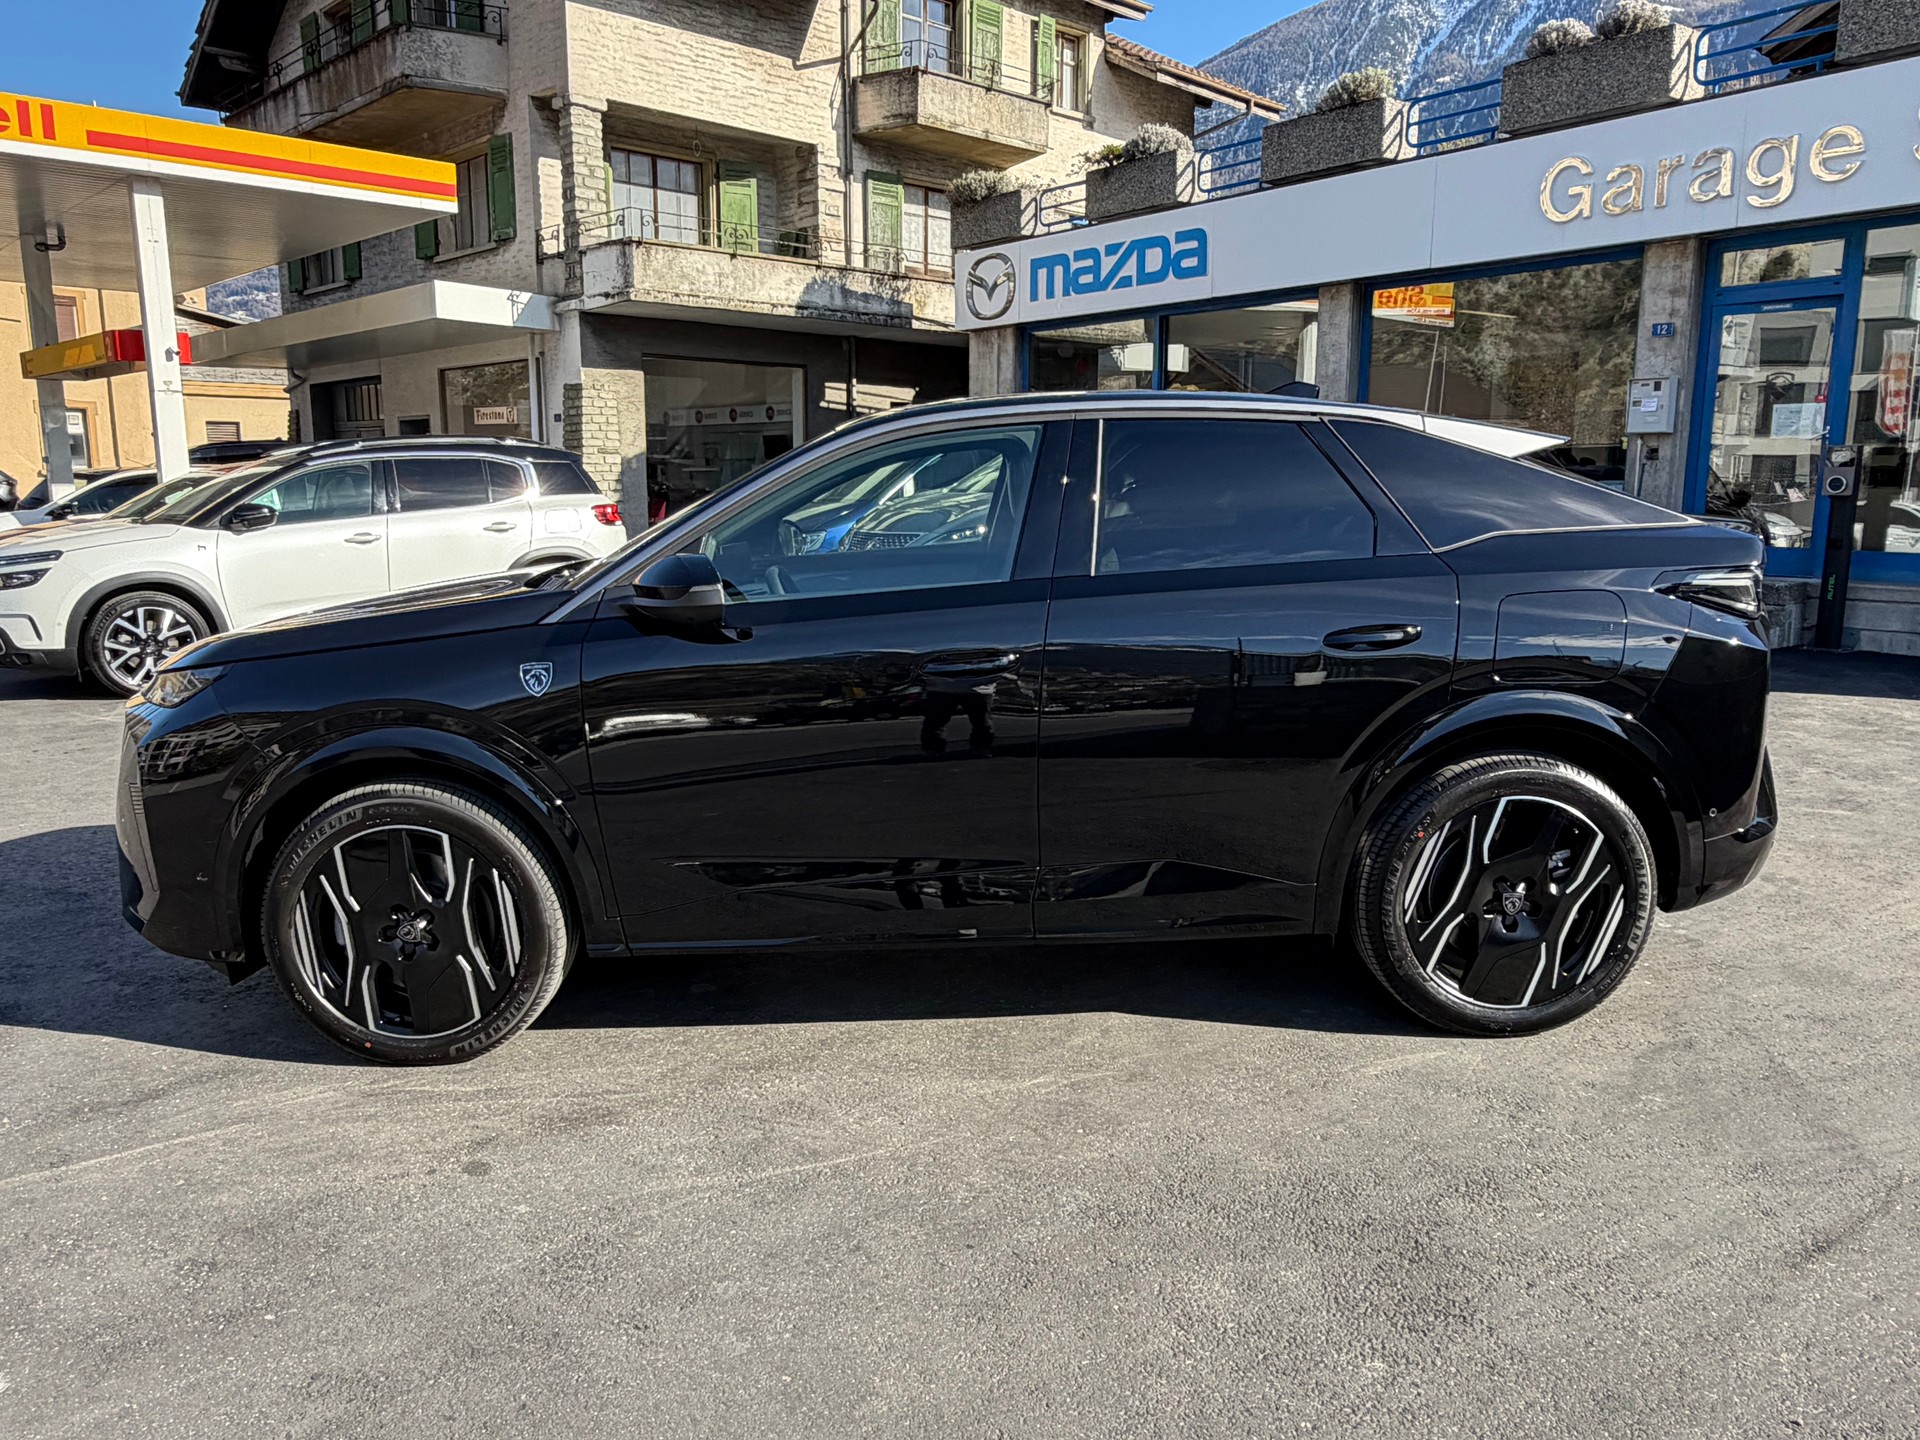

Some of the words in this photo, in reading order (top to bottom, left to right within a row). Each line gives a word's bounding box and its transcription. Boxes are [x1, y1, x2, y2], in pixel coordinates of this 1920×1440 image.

[1539, 124, 1866, 223] Garage
[1657, 324, 1668, 335] 12
[476, 405, 505, 422] Firestone
[1630, 858, 1648, 944] MICHELIN
[455, 995, 526, 1055] MICHELIN
